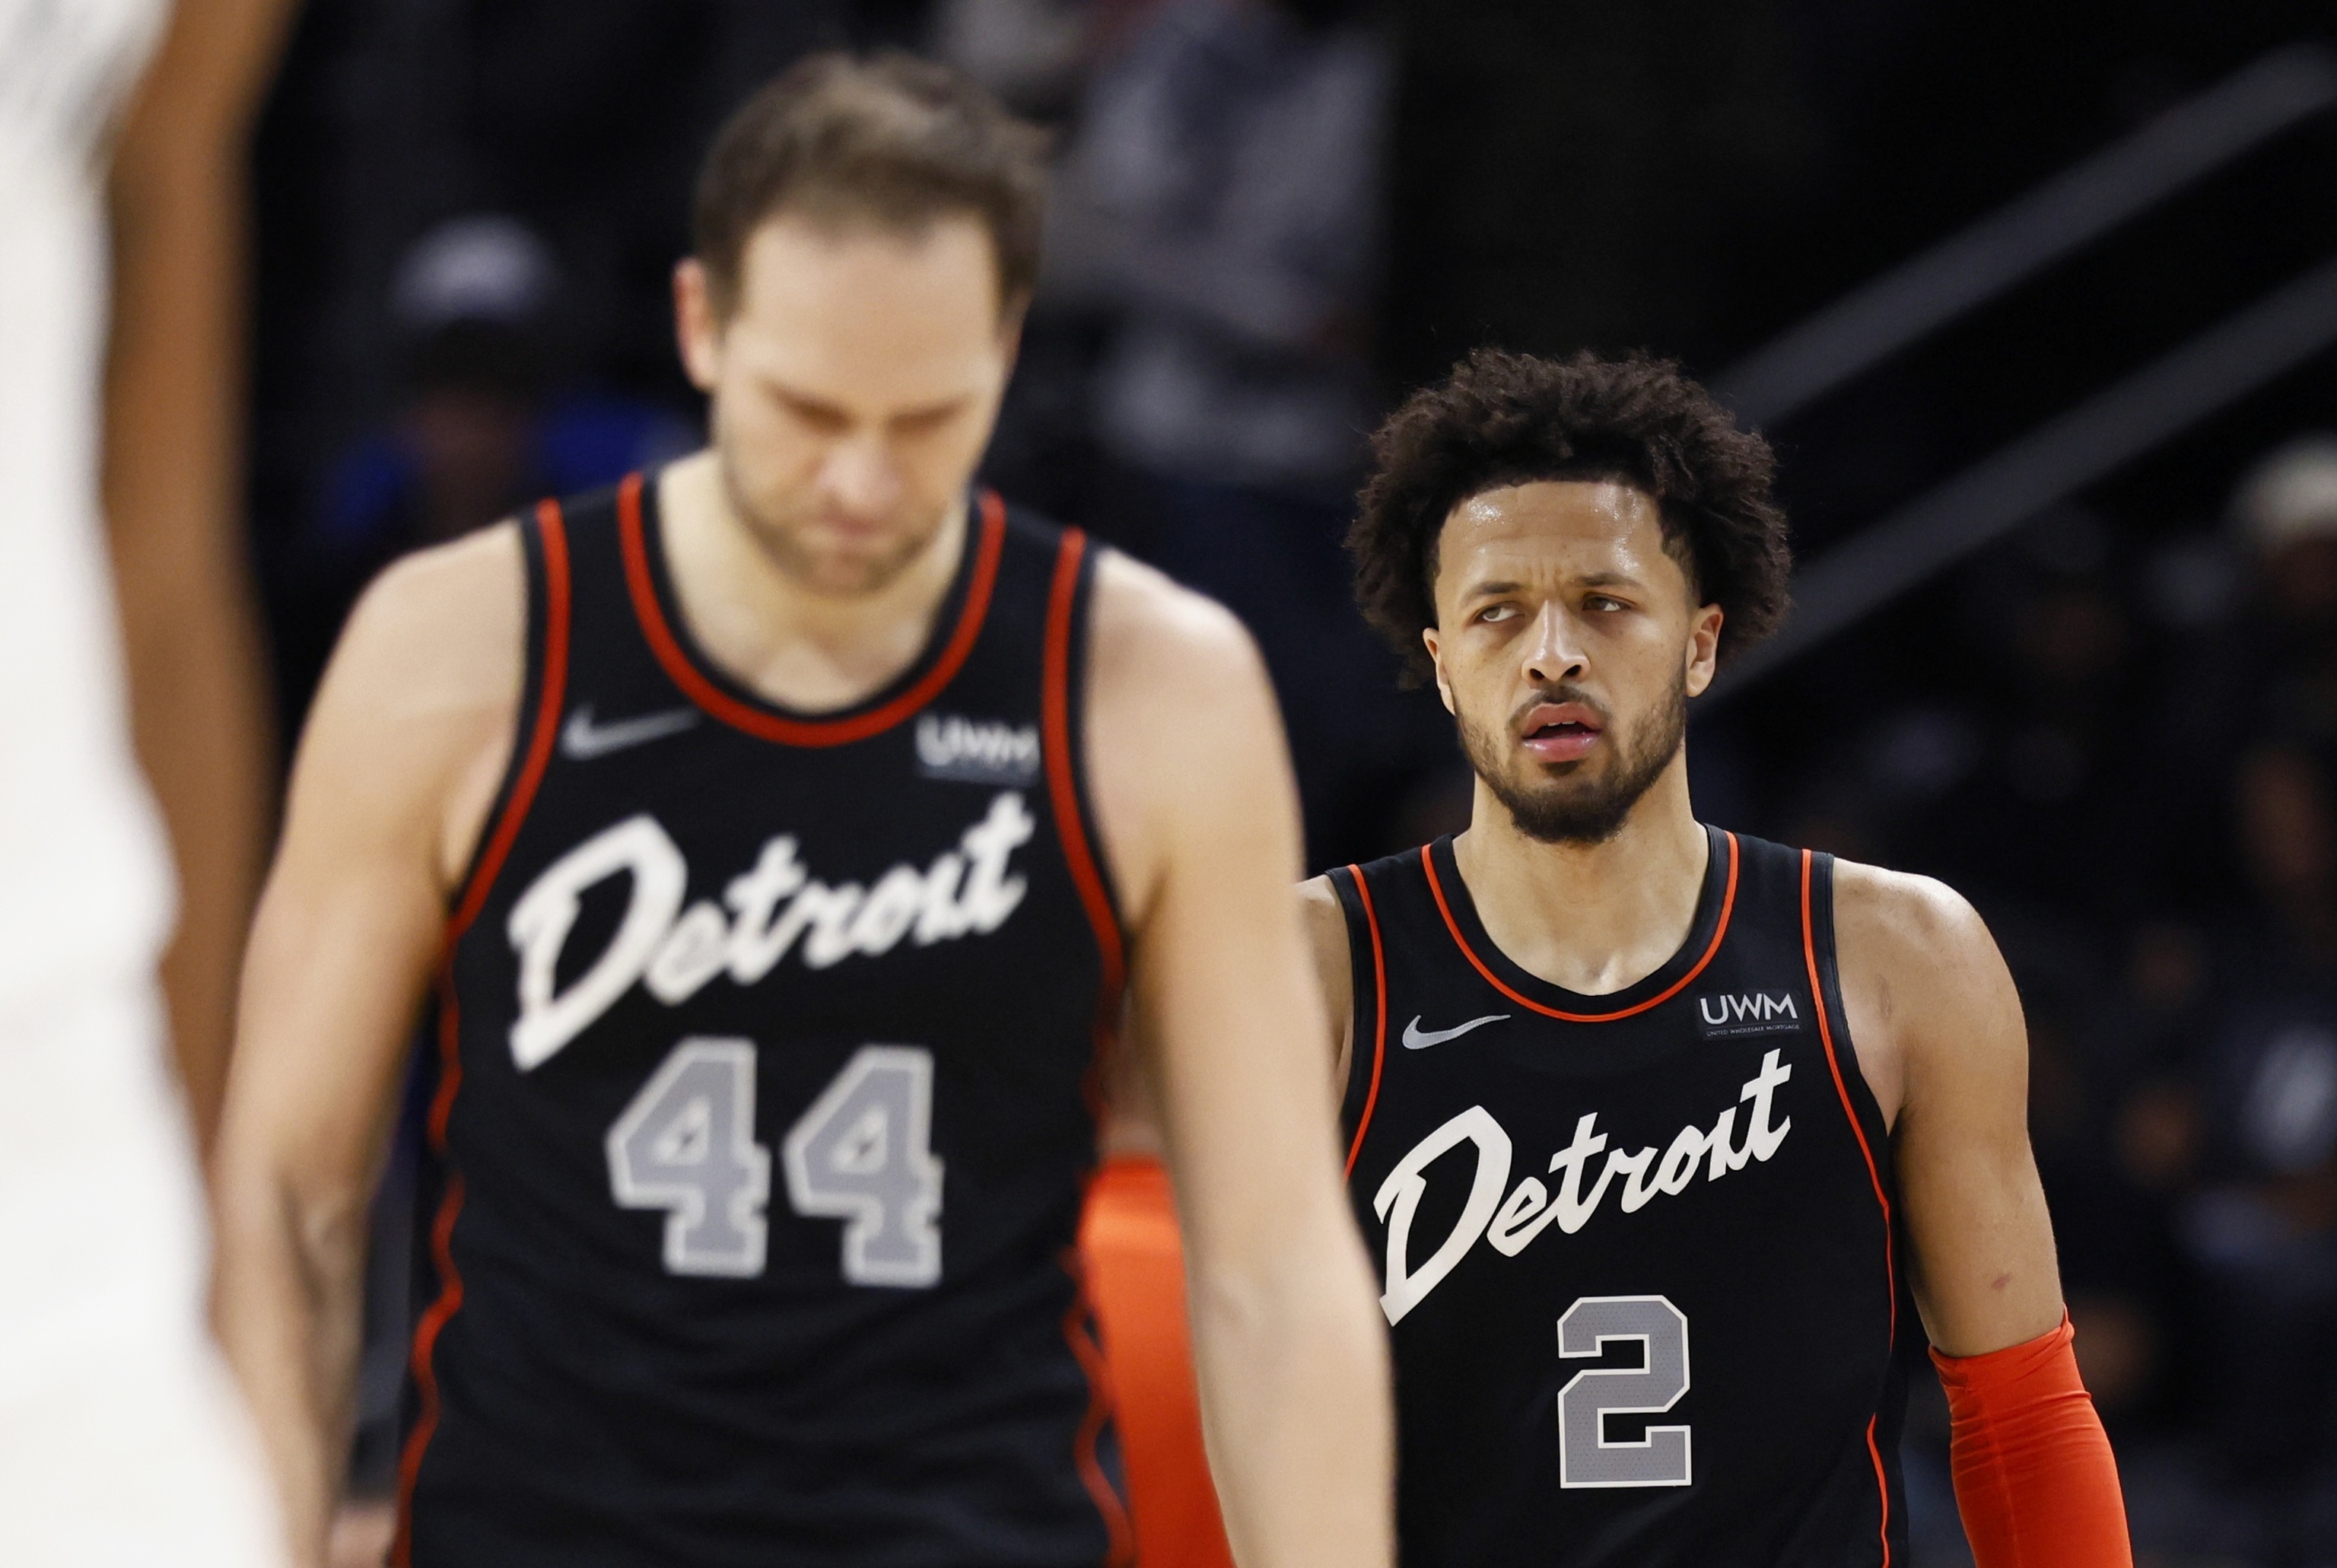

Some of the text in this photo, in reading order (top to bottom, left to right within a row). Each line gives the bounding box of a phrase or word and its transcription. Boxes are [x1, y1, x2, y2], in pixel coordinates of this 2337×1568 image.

[509, 791, 1035, 1070] Detroit
[1699, 993, 1798, 1025] UWM
[1730, 1026, 1764, 1034] WHOLESALE
[606, 1036, 943, 1287] 44
[1373, 1048, 1792, 1327] Detroit
[1557, 1295, 1692, 1488] 2
